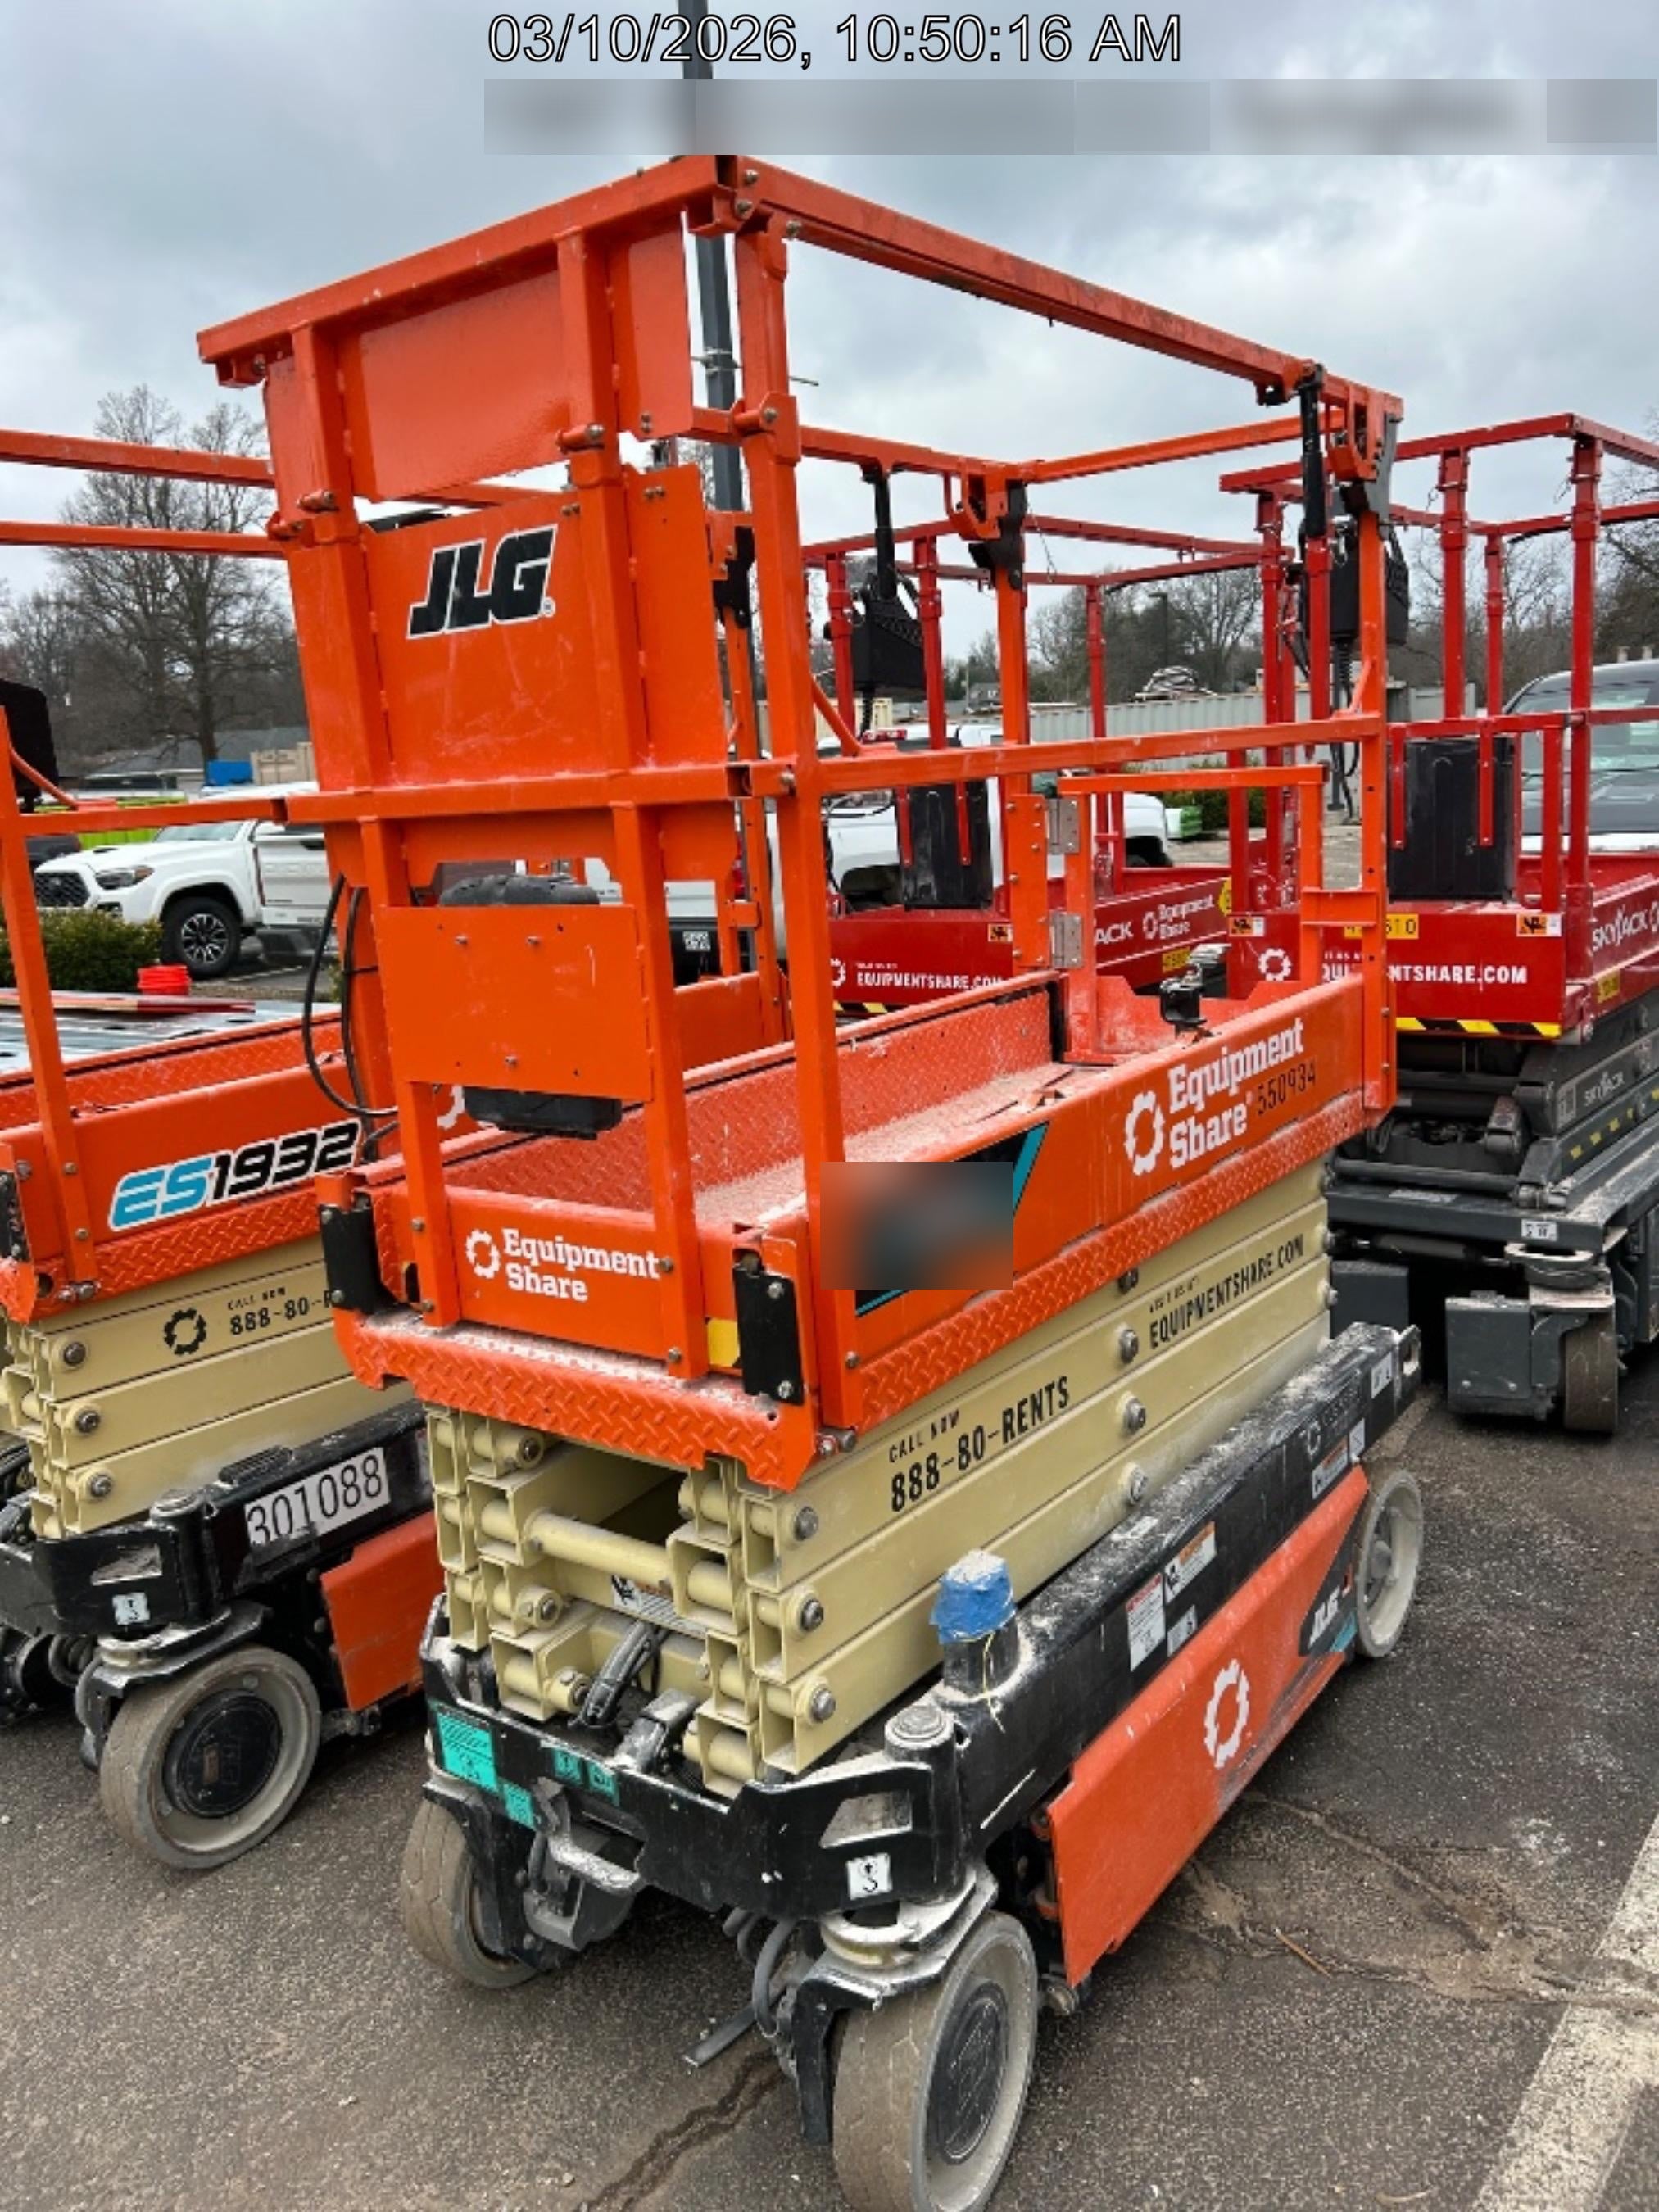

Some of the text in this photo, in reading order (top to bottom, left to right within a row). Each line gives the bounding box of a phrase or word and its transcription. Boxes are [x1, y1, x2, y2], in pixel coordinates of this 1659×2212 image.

[406, 523, 559, 639] JLG
[1168, 1017, 1304, 1115] Equipment
[1258, 1062, 1317, 1117] 550934
[1169, 1103, 1248, 1169] Share
[109, 1118, 361, 1232] ES1932
[501, 1228, 661, 1280] Equipment
[505, 1262, 589, 1303] Share
[230, 1290, 332, 1335] 888-80-R
[889, 1435, 924, 1463] CALL
[891, 1375, 1071, 1513] 888-80-RENTS
[247, 1454, 382, 1544] 301088
